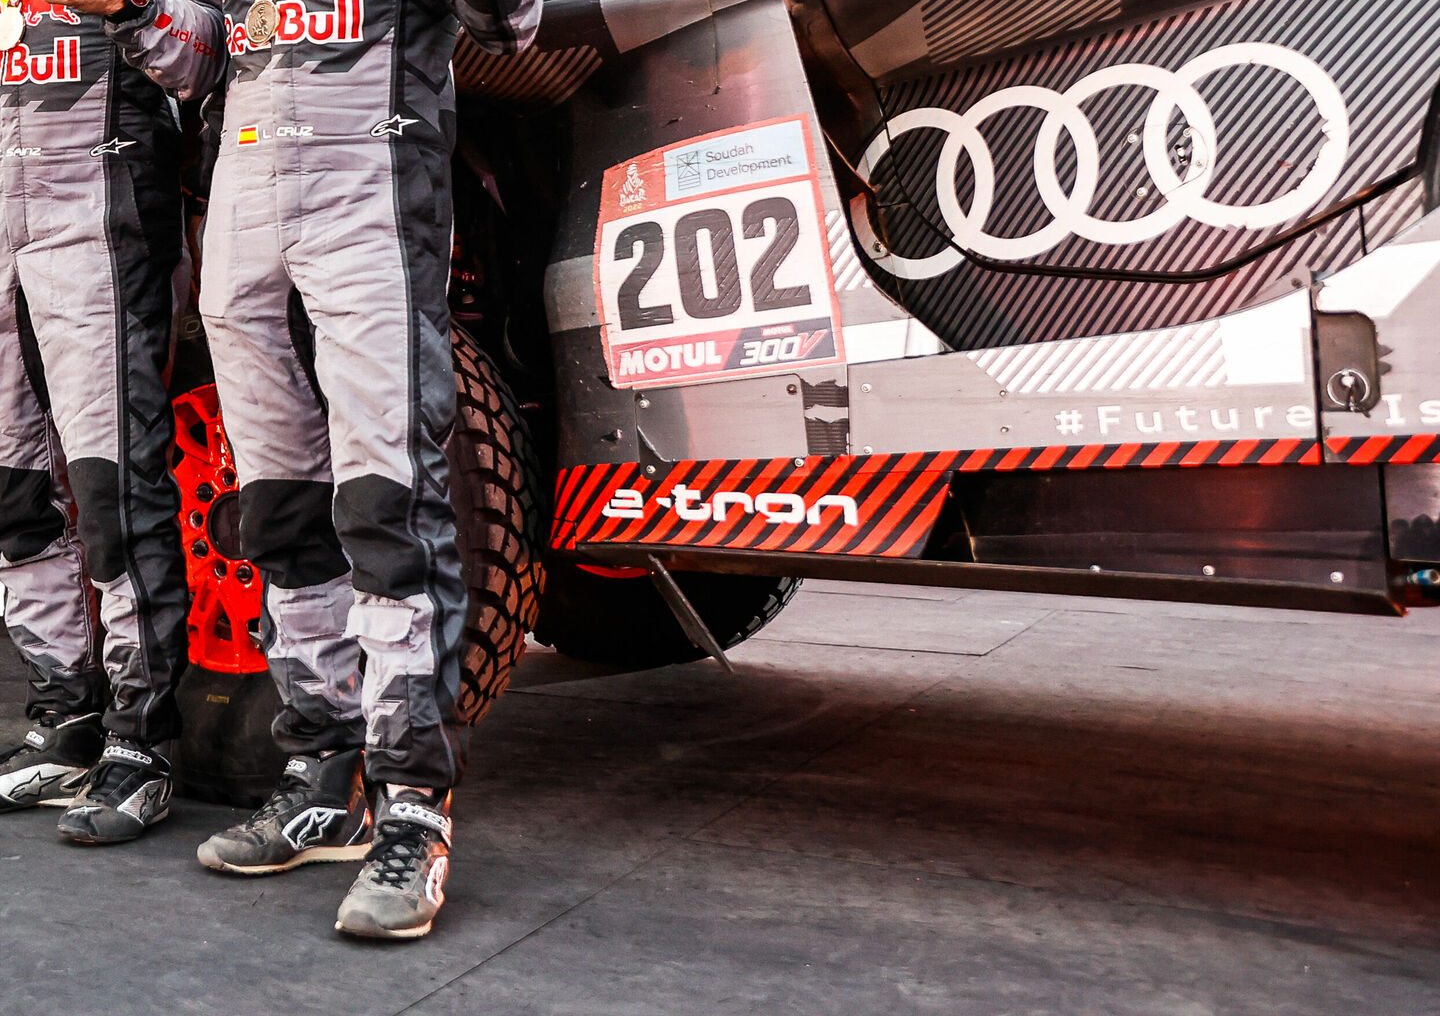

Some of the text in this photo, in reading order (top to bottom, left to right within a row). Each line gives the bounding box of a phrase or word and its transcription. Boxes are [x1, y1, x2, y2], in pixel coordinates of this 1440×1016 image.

[4, 36, 82, 84] Bull
[276, 125, 314, 137] CRUZ
[705, 142, 755, 163] Soudah
[706, 154, 793, 181] Development
[613, 196, 812, 332] 202
[617, 328, 828, 377] MOTUL 300V
[1054, 403, 1316, 436] #Future
[600, 483, 859, 527] e-tron
